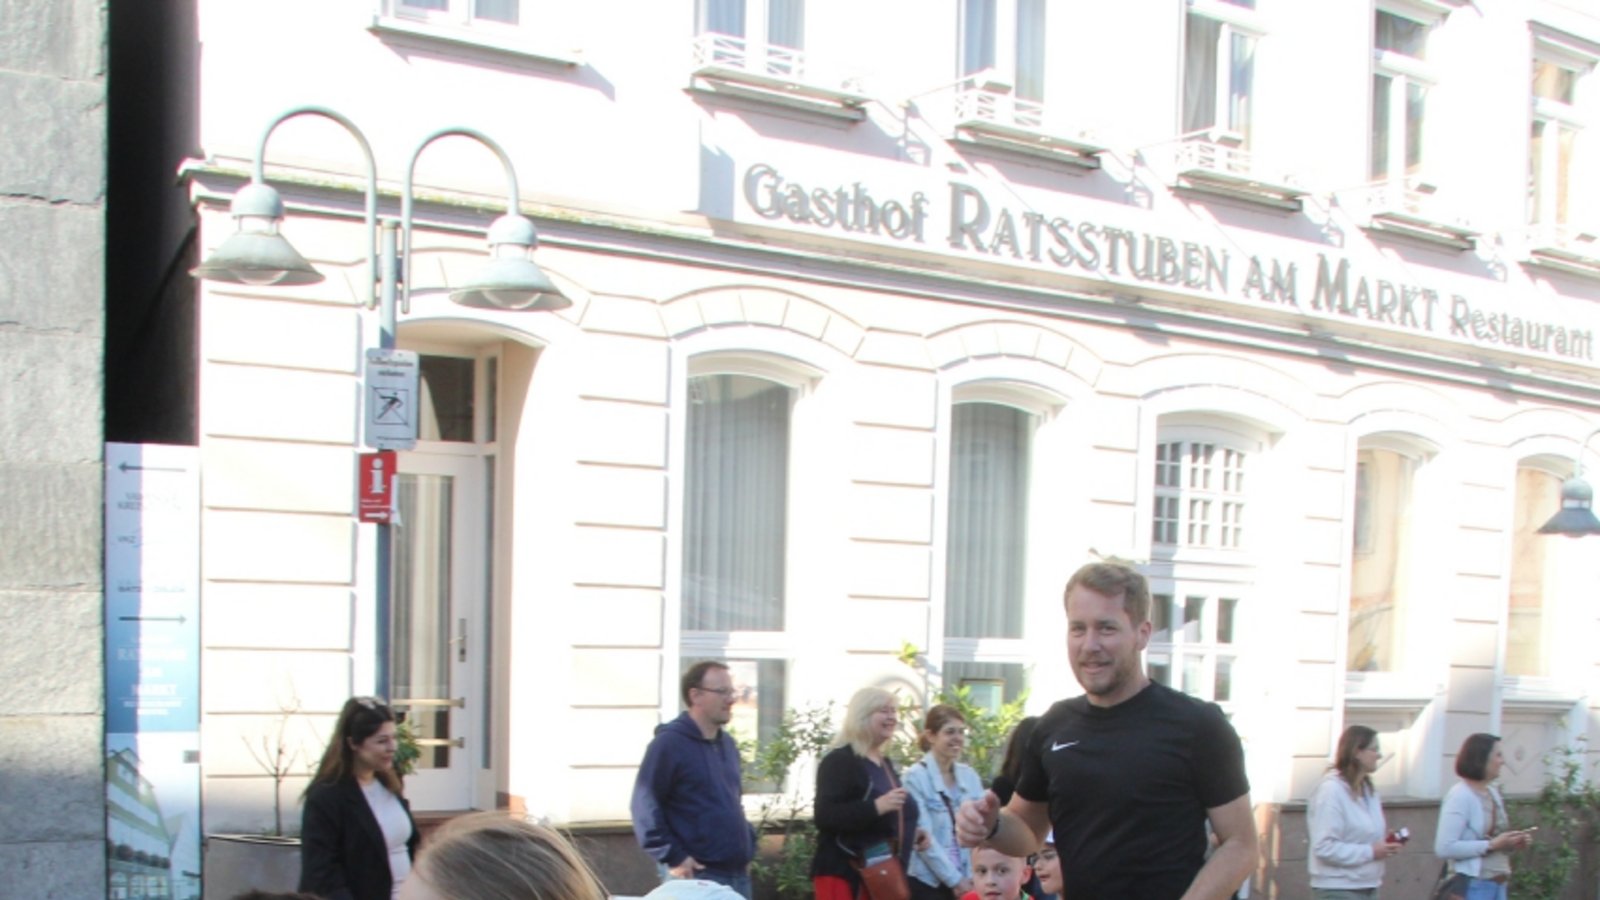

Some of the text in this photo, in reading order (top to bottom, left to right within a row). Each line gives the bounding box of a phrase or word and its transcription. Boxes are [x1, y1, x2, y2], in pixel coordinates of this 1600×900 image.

[743, 163, 1594, 361] Gasthof RATSSTUBEN AM MARKT Restaurant
